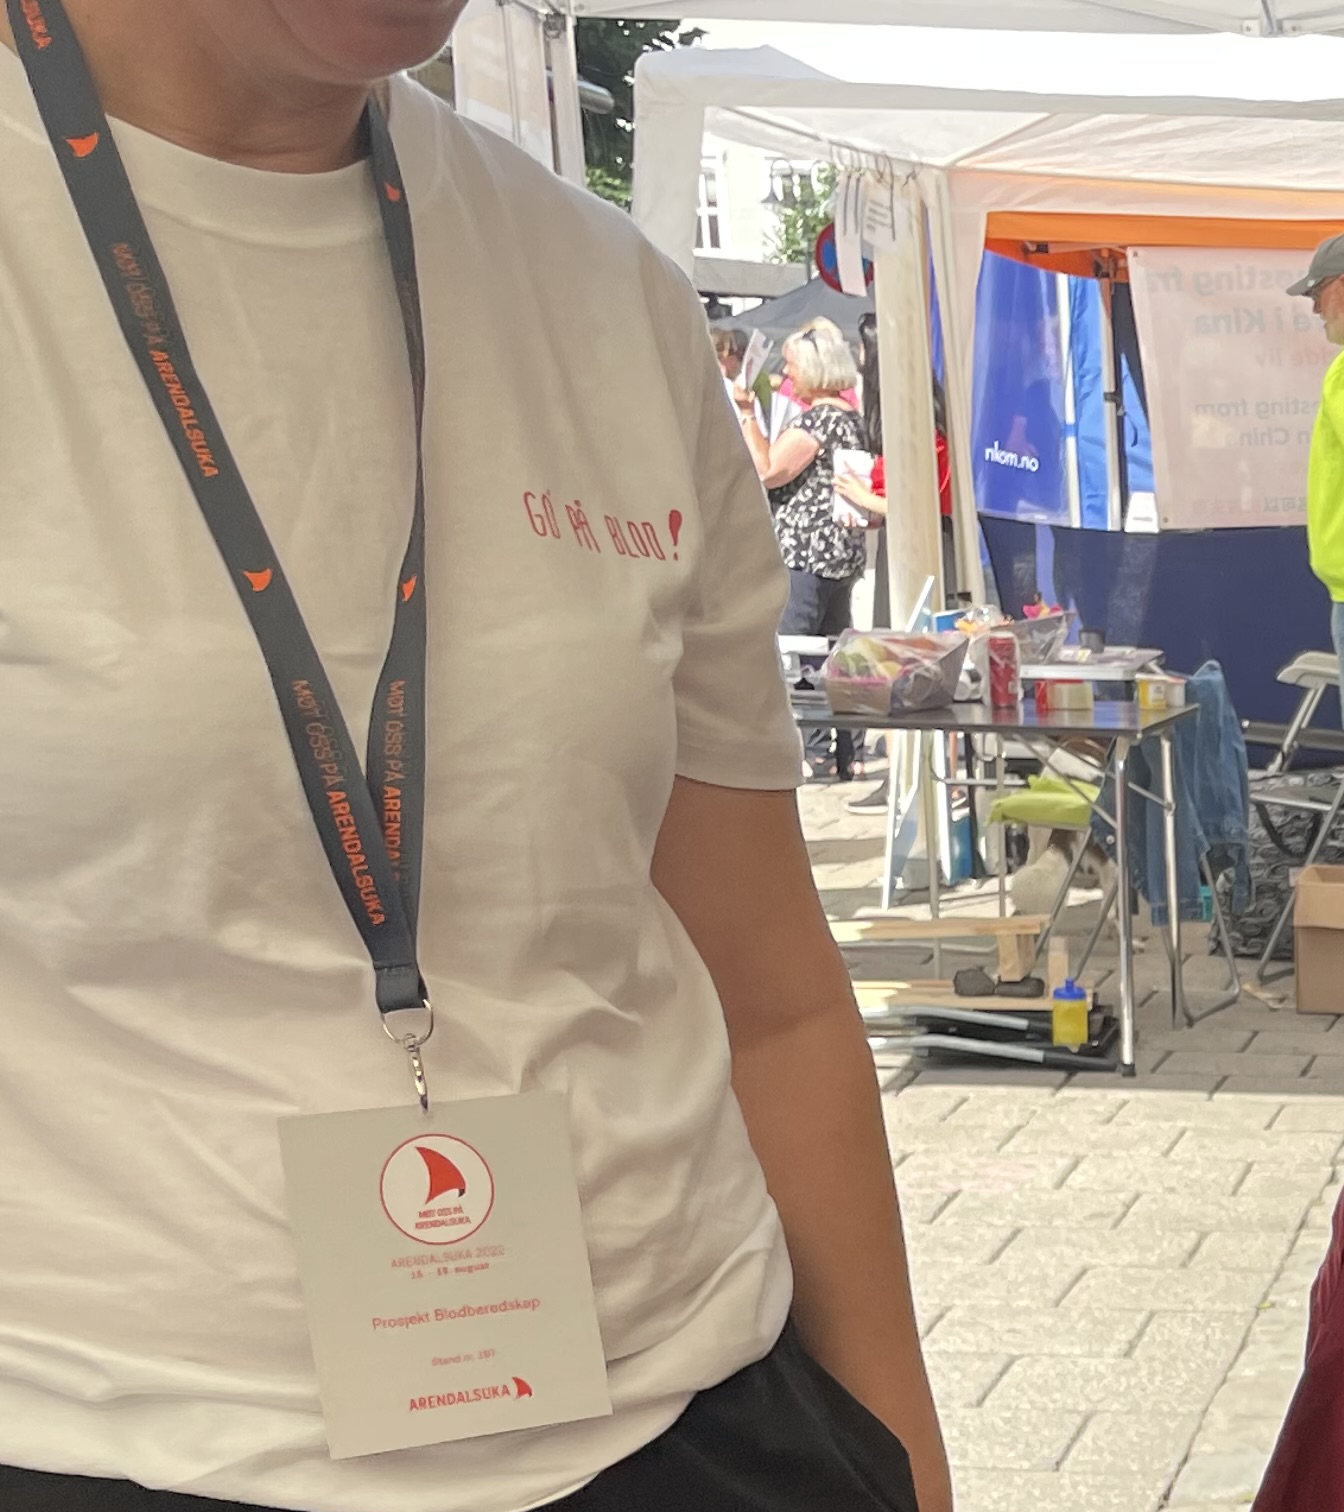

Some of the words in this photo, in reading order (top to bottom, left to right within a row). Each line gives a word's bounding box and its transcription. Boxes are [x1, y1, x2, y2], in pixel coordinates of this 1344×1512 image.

[150, 350, 219, 478] ARENDALSUKA
[985, 440, 1039, 472] nkom.no
[565, 500, 601, 554] PÅ
[326, 790, 386, 927] ARENDALSUKA
[372, 1311, 431, 1331] Prosjekt
[434, 1298, 541, 1322] Blodberedskap
[409, 1384, 511, 1411] ARENDALSUKA
